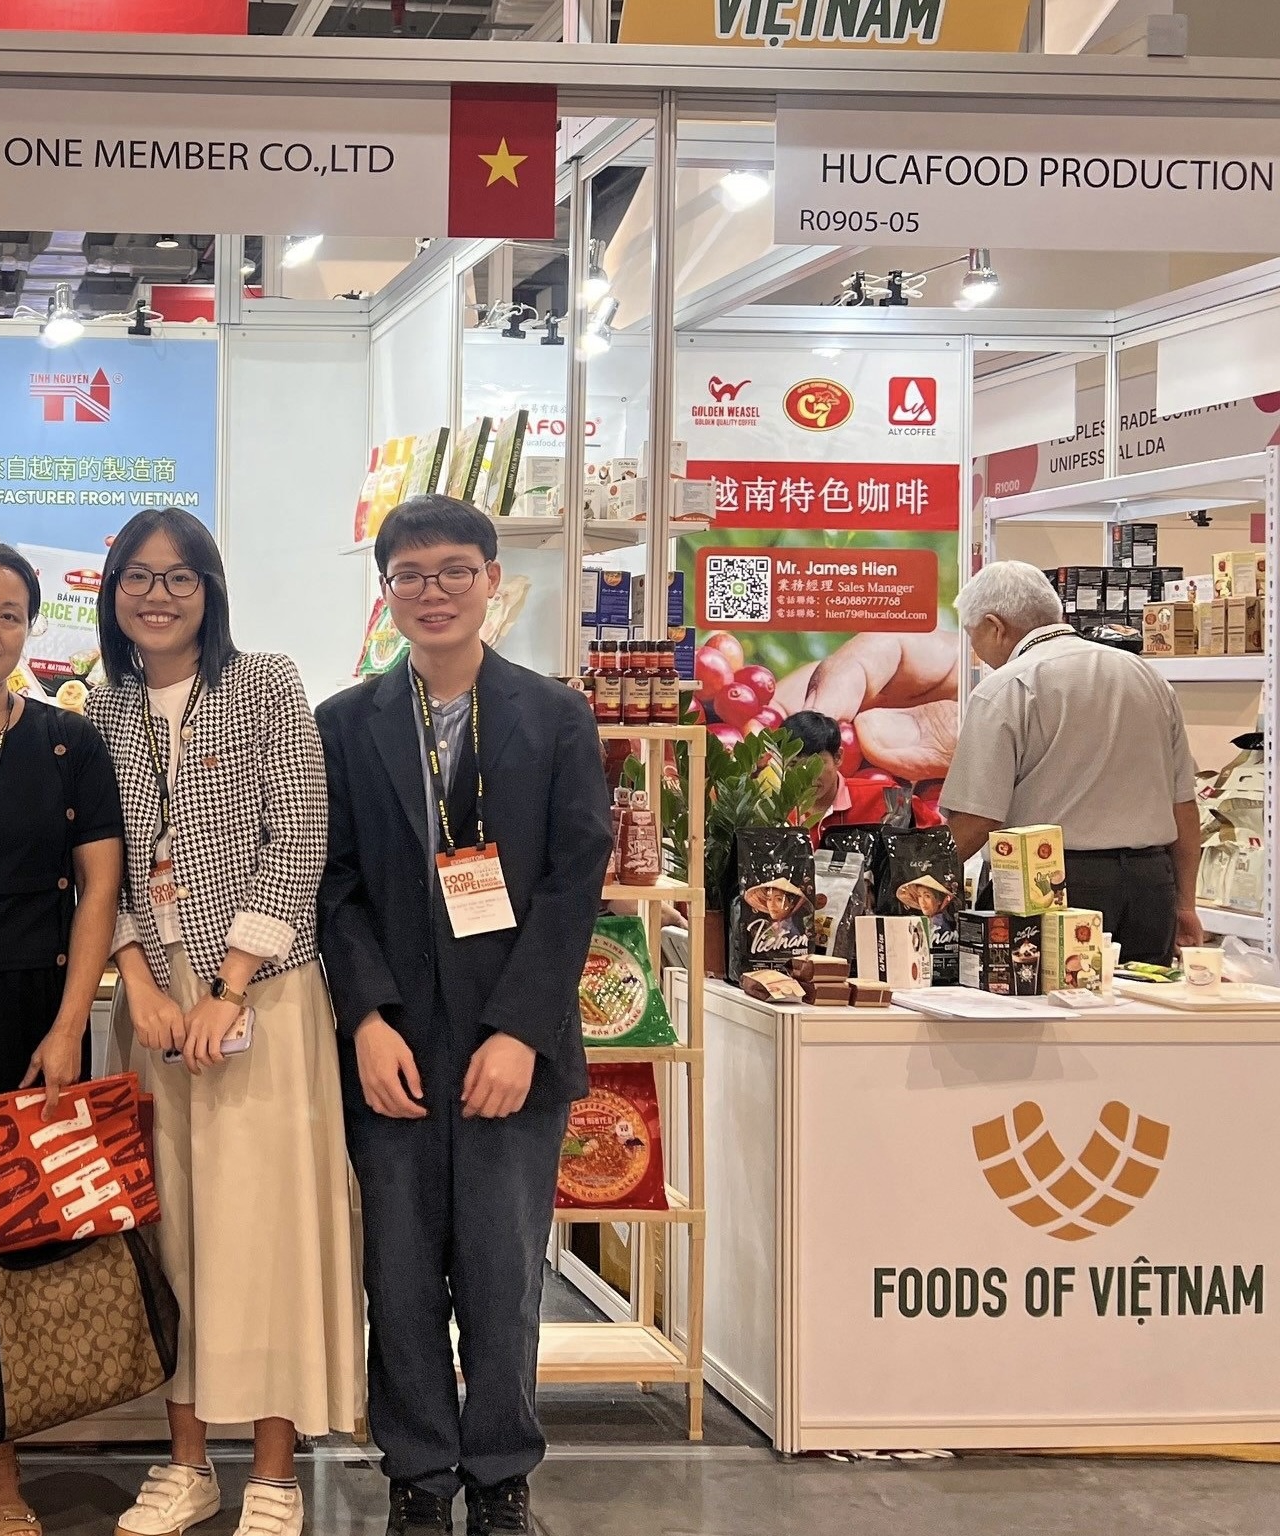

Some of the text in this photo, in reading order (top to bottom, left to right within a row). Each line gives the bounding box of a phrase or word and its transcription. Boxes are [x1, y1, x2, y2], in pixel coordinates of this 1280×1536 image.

[4, 136, 83, 168] ONE
[94, 139, 249, 172] MEMBER
[260, 142, 395, 176] CO.,LTD
[821, 152, 1275, 192] HUCAFOOD PRODUCTION
[799, 209, 920, 234] R0905-05
[30, 372, 51, 385] TINH
[691, 405, 760, 418] GOLDEN WEASEL
[1120, 407, 1158, 432] RADE
[694, 418, 757, 427] GOLDEN QUALITY COFFEE
[888, 428, 937, 437] ALY COFFEE
[1049, 436, 1166, 474] UNIPESSAL LDA
[994, 478, 1020, 495] R1000
[79, 489, 126, 505] FROM
[128, 490, 199, 507] VIETNAM
[776, 560, 897, 577] Mr. James Hien
[57, 592, 80, 603] BÁNH
[837, 581, 865, 594] Sales
[867, 582, 915, 597] Manager
[41, 601, 73, 621] RICE
[825, 608, 928, 620] hien79@hucafood.com
[443, 871, 474, 885] FOOD
[446, 880, 481, 895] TAIPEI
[746, 918, 809, 955] Vietnam
[873, 1255, 1264, 1326] FOODS OF VIỆTNAM
